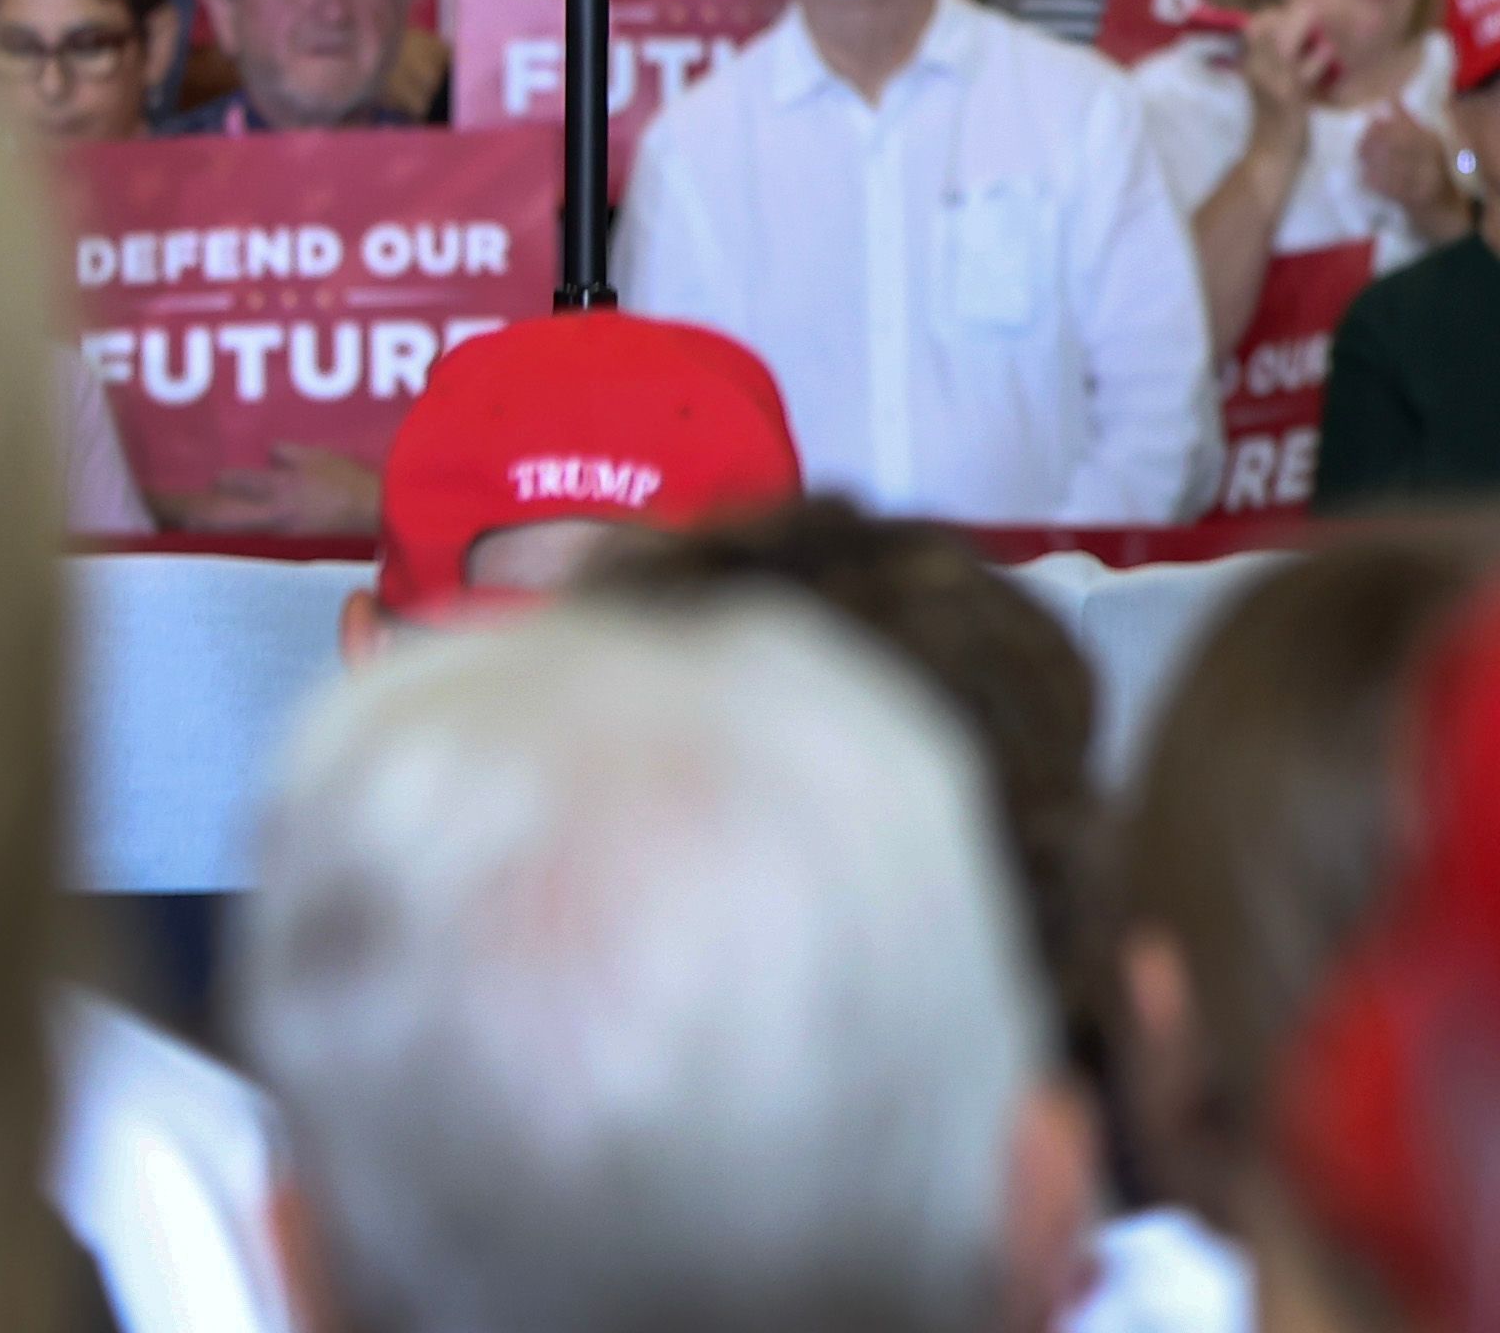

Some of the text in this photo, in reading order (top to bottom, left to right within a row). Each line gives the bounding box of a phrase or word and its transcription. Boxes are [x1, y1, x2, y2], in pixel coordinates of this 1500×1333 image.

[76, 221, 512, 289] DEFEND OUR
[508, 454, 663, 508] TRUMP
